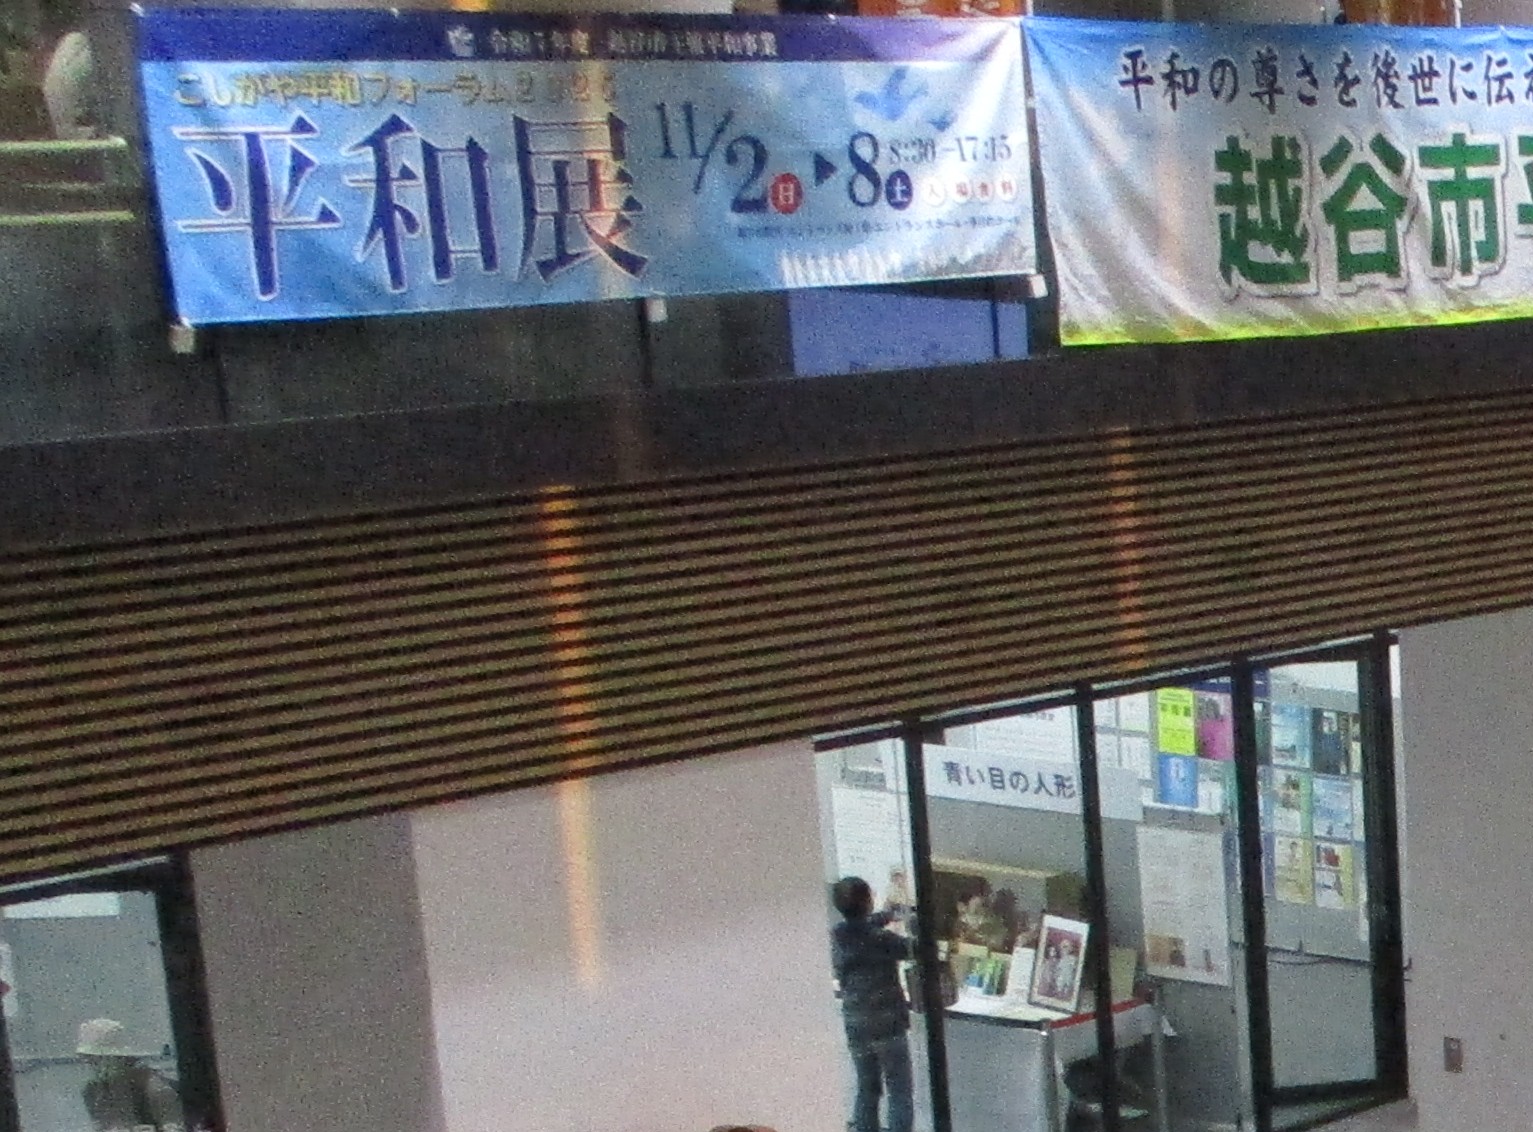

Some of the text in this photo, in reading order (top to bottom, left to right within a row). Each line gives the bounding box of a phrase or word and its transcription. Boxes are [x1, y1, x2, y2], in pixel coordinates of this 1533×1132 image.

[172, 111, 650, 302] 平和展
[848, 131, 882, 208] 8
[942, 758, 1076, 799] 青い目の人形
